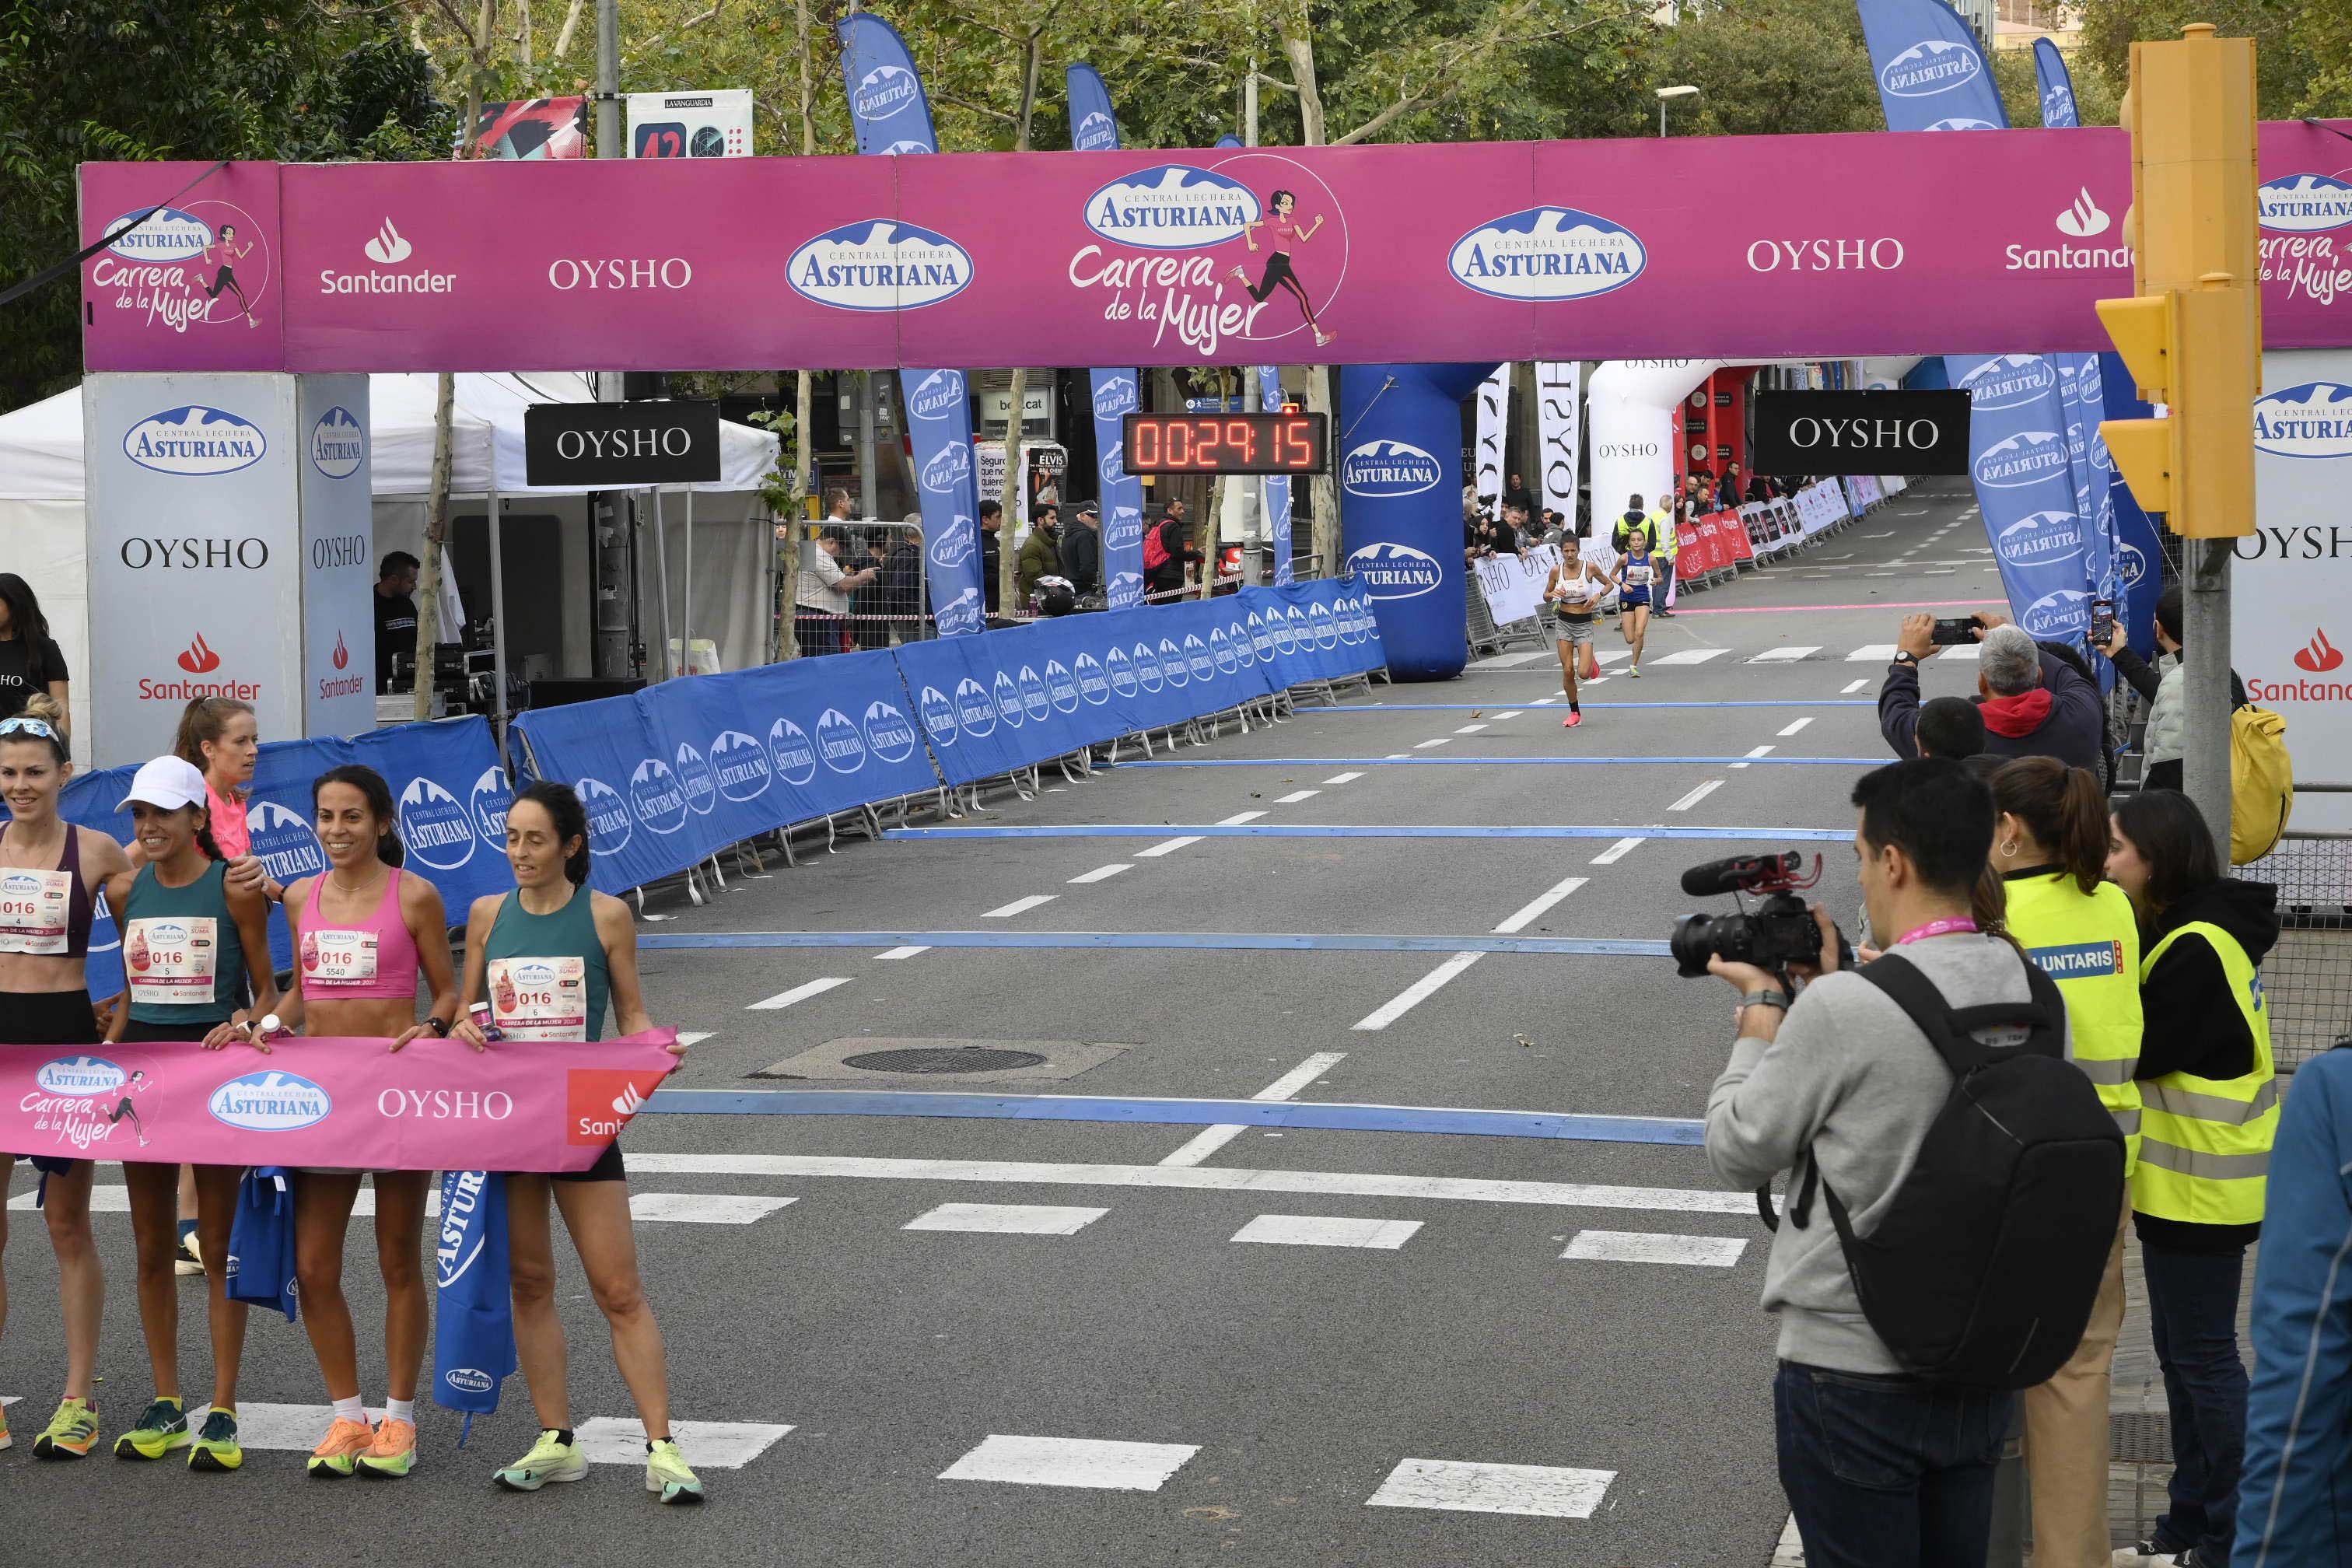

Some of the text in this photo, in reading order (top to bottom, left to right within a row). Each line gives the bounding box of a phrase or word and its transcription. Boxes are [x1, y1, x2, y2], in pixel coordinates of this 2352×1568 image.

[674, 98, 712, 107] VANGUARDIA
[1125, 193, 1242, 203] CENTRAL LECHERA
[1097, 197, 1247, 228] ASTURIANA
[111, 226, 205, 248] ASTURIANA
[1494, 237, 1625, 250] CENTRAL LECHERA
[2259, 236, 2333, 258] arrera
[828, 250, 953, 261] CENTRAL LECHERA
[1069, 245, 1214, 288] Carrera
[1464, 243, 1631, 278] ASTURIANA
[1747, 237, 1904, 272] OYSHO
[2006, 244, 2134, 270] Santand
[93, 258, 184, 287] Carrera
[320, 269, 457, 293] Santander
[548, 258, 691, 290] OYSHO
[800, 254, 958, 287] ASTURIANA
[2277, 258, 2352, 306] la Muje
[116, 285, 219, 333] de la Mujer
[1104, 284, 1269, 356] de la Mujer
[135, 432, 256, 457] ASTURIANA
[206, 429, 251, 437] LECHERA
[556, 427, 691, 459] OYSHO
[1789, 417, 1939, 450] OYSHO
[315, 434, 360, 461] ASTURIANA
[1039, 455, 1063, 465] ELVIS
[1599, 443, 1657, 457] OYSHO
[982, 468, 993, 478] que
[1346, 463, 1433, 485] ASTURIANA
[121, 538, 268, 569] OYSHO
[313, 534, 365, 569] OYSHO
[139, 678, 261, 700] Santander
[320, 674, 362, 699] Santander
[822, 733, 863, 760] ASTURIANA
[715, 758, 768, 788] ASTURIANA
[412, 806, 459, 821] CENTRAL LECHERA
[253, 830, 310, 850] CENTRAL LECHERA
[406, 815, 472, 849] ASTURIANA
[262, 845, 321, 879] STURIANA
[152, 952, 183, 963] 016
[322, 952, 352, 964] 016
[520, 992, 551, 1004] 016
[44, 1070, 117, 1088] ASTURIANA
[20, 1091, 91, 1113] Carrera
[217, 1092, 321, 1115] ASTURIANA
[378, 1088, 513, 1120] OYSHO
[34, 1111, 118, 1149] de la Mujer
[579, 1118, 623, 1136] Sant
[437, 1171, 487, 1277] ASTUR
[450, 1374, 489, 1388] ASTURIANA
